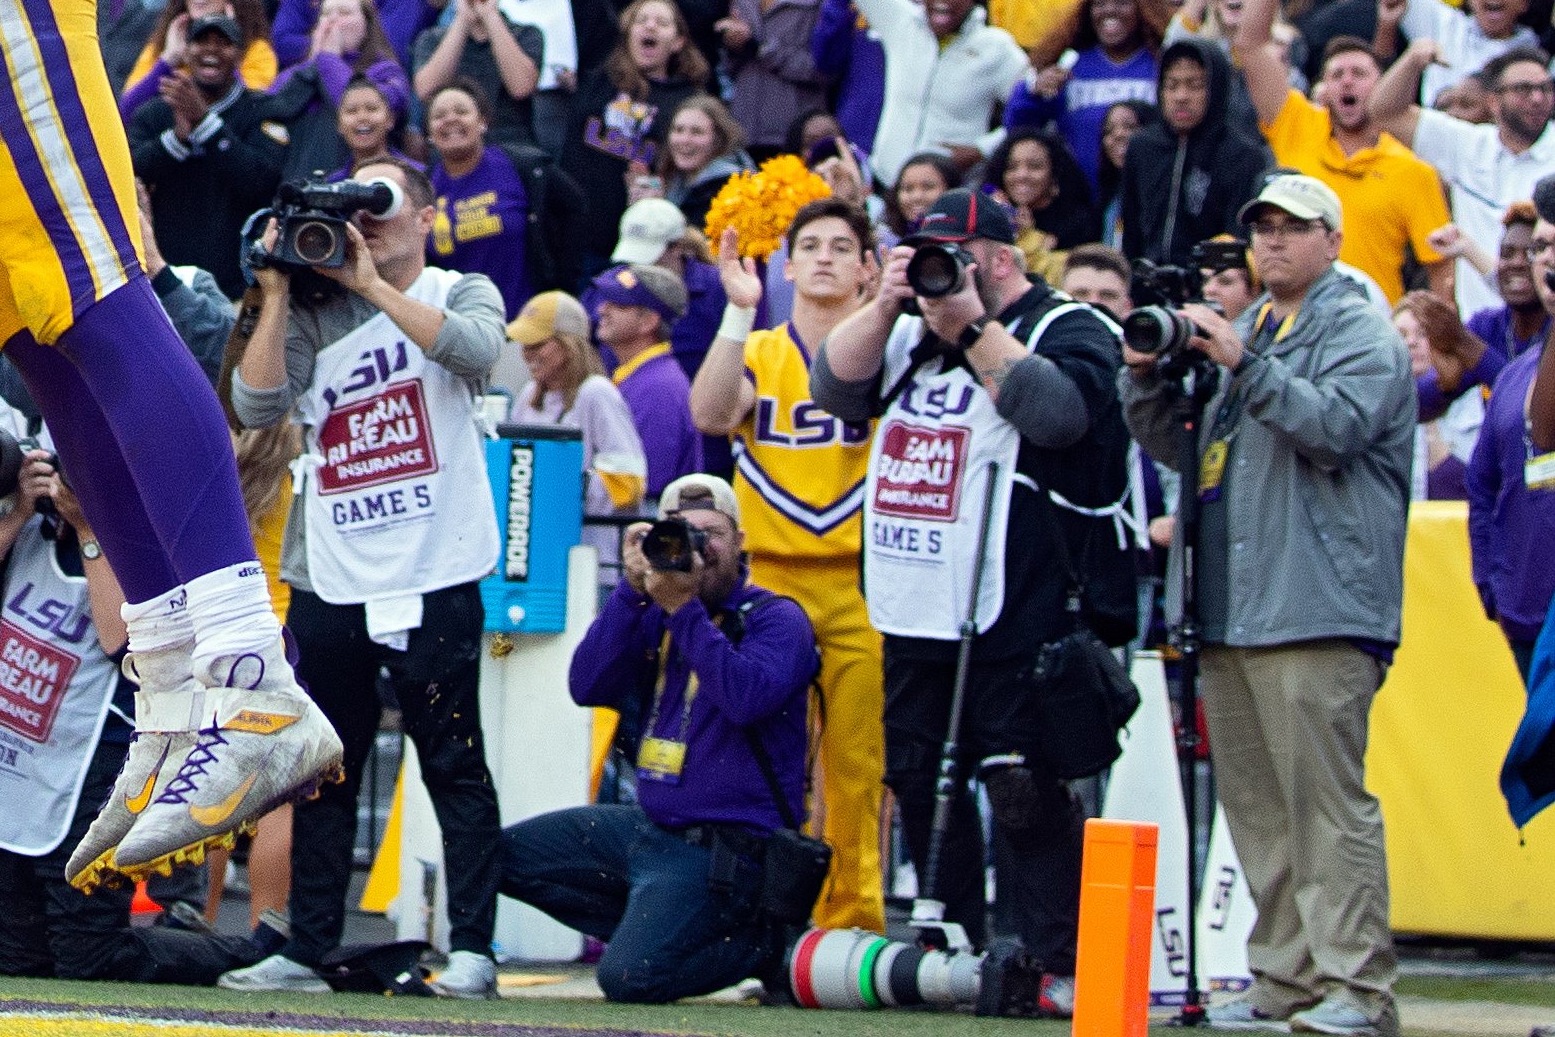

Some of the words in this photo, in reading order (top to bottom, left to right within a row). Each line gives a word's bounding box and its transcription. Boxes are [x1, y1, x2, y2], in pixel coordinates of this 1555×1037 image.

[585, 116, 656, 165] LSU
[337, 449, 425, 480] INSURANCE
[332, 490, 407, 526] GAME
[414, 484, 432, 509] 5
[505, 448, 533, 579] POWERADE
[7, 581, 91, 643] LSU
[1, 637, 60, 682] FARM
[1156, 907, 1188, 977] LSU
